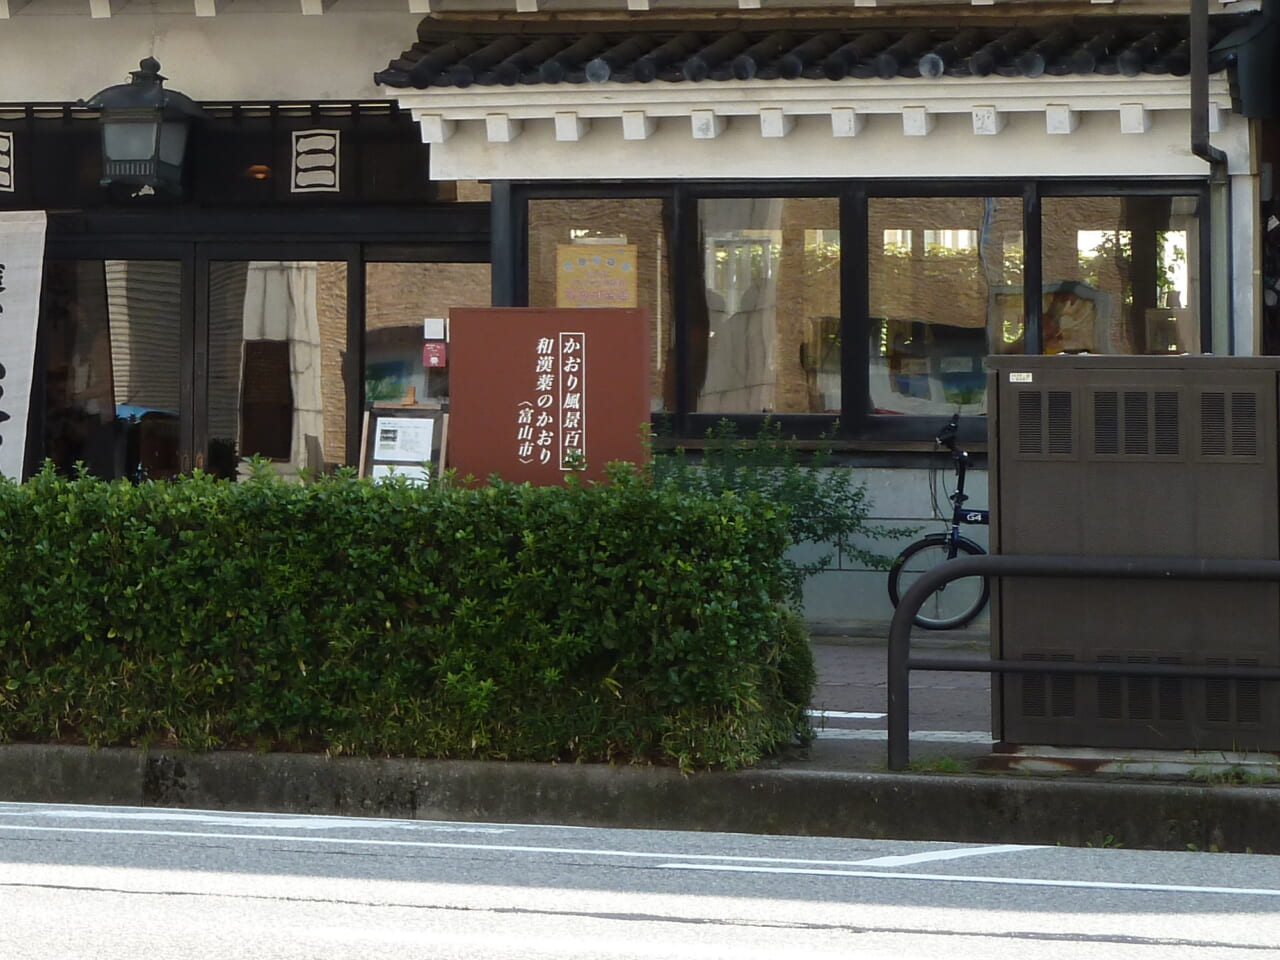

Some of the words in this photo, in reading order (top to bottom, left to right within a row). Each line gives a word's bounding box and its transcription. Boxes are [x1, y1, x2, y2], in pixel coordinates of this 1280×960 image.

[535, 337, 555, 465] 和漢薬のかおり
